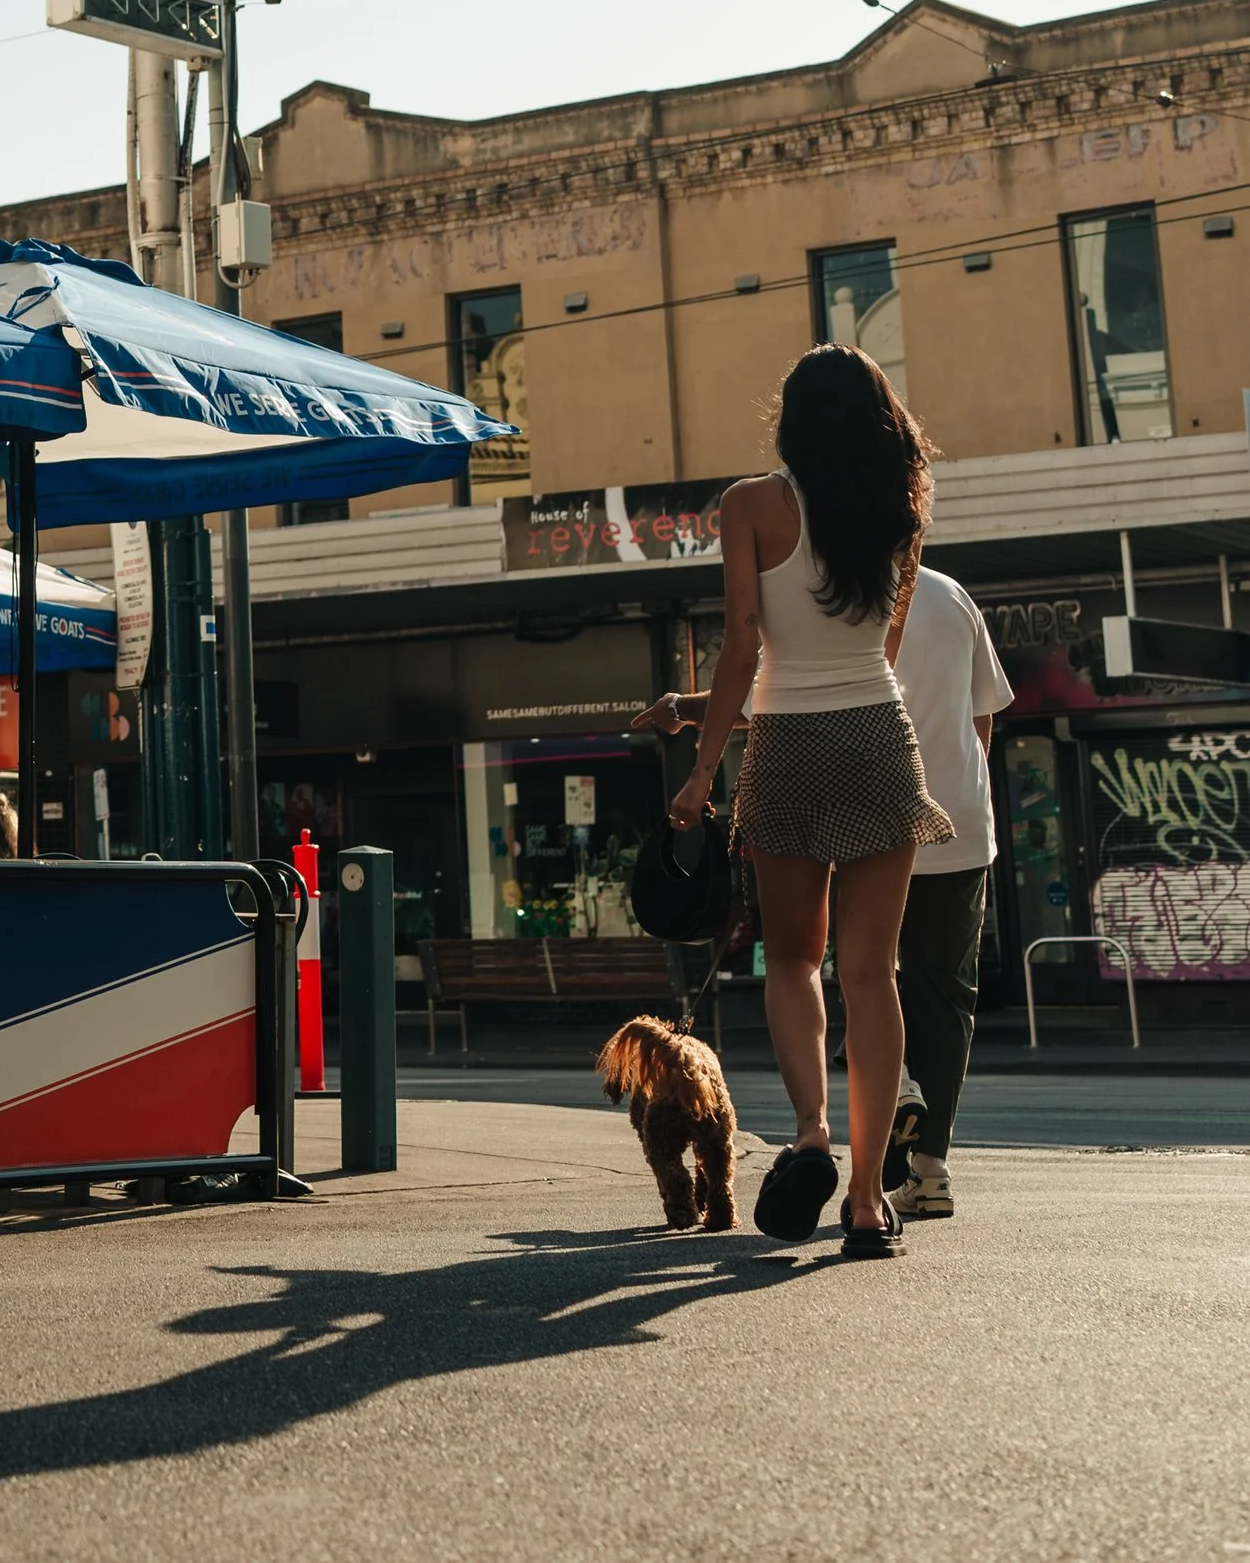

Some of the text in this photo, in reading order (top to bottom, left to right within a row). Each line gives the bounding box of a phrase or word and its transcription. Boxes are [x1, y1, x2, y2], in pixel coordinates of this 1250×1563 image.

[215, 393, 249, 417] WE
[249, 393, 307, 423] SERE
[530, 501, 590, 524] House of
[527, 509, 721, 556] reverenc
[50, 616, 86, 640] GOATS
[486, 700, 647, 720] SAMESAMEBUTDIFFERENT.SALON
